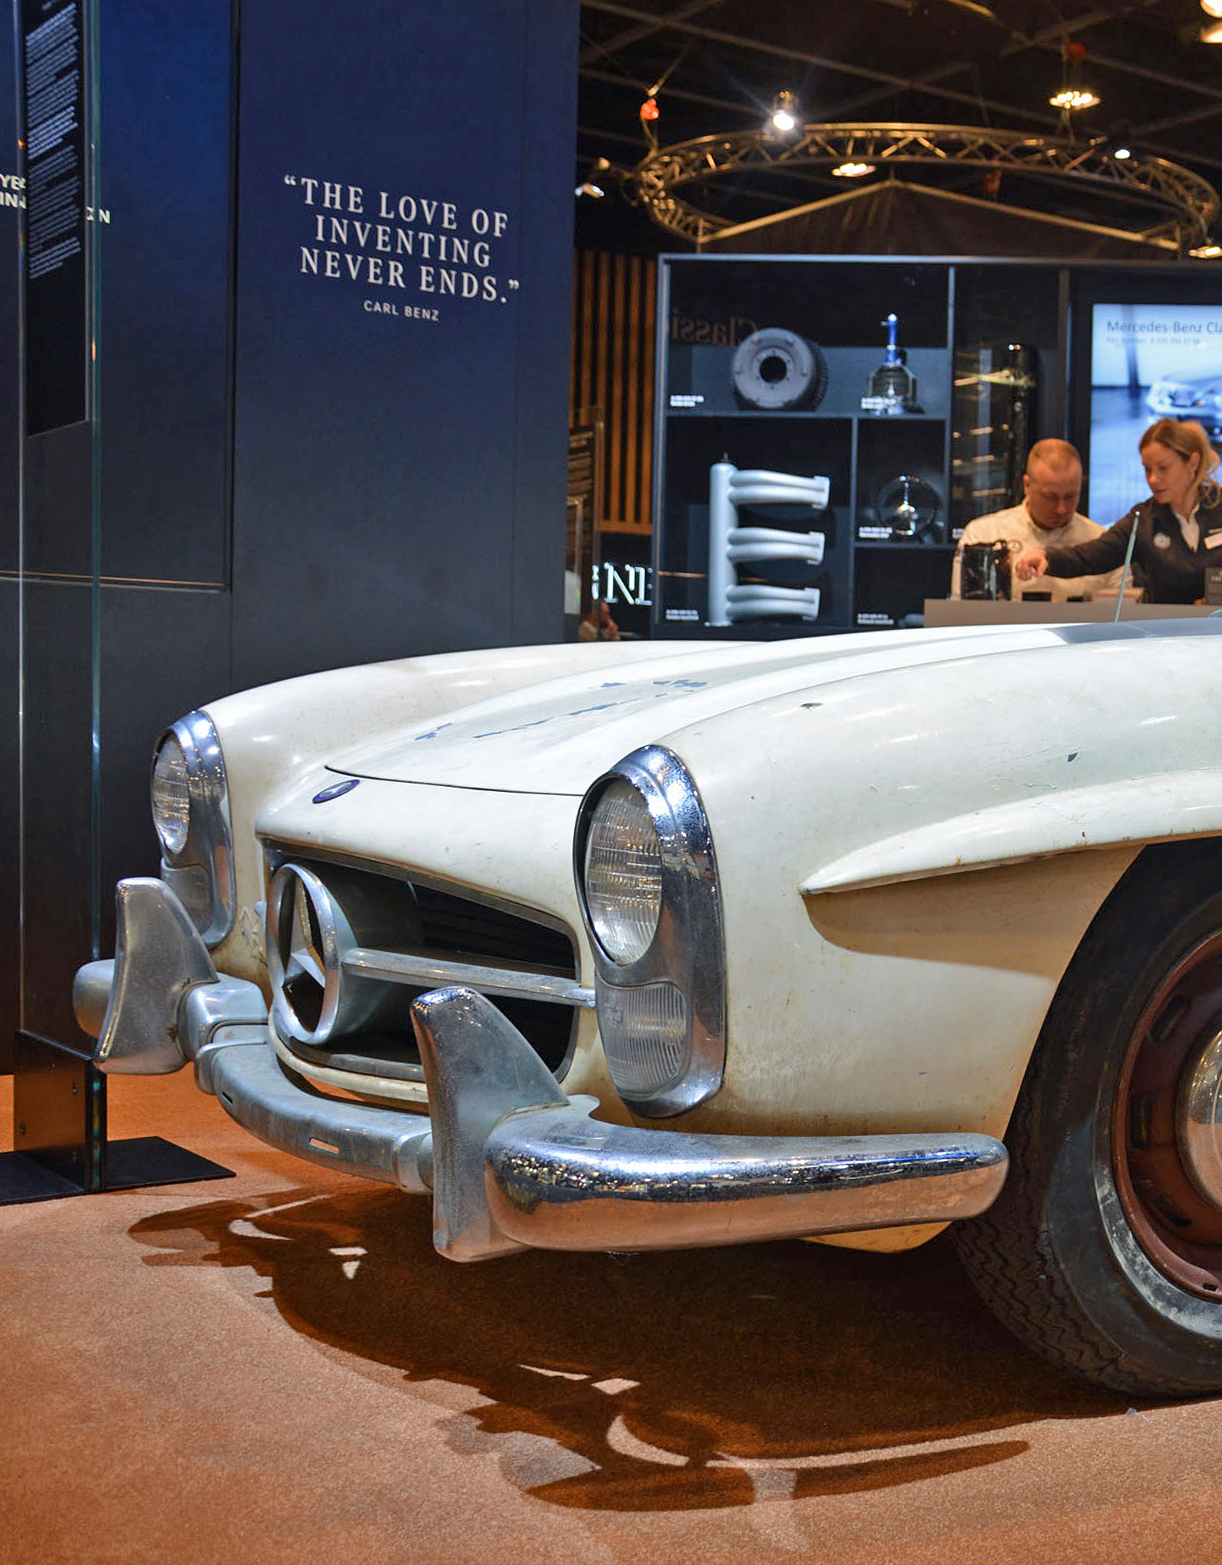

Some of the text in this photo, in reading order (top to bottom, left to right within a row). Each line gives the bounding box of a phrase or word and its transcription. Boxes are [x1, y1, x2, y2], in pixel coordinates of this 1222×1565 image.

[379, 191, 458, 231] LOVE
[471, 208, 509, 238] OF
[315, 214, 491, 268] INVENTING
[300, 246, 406, 289] NEVER
[363, 300, 440, 322] CARL BENZ
